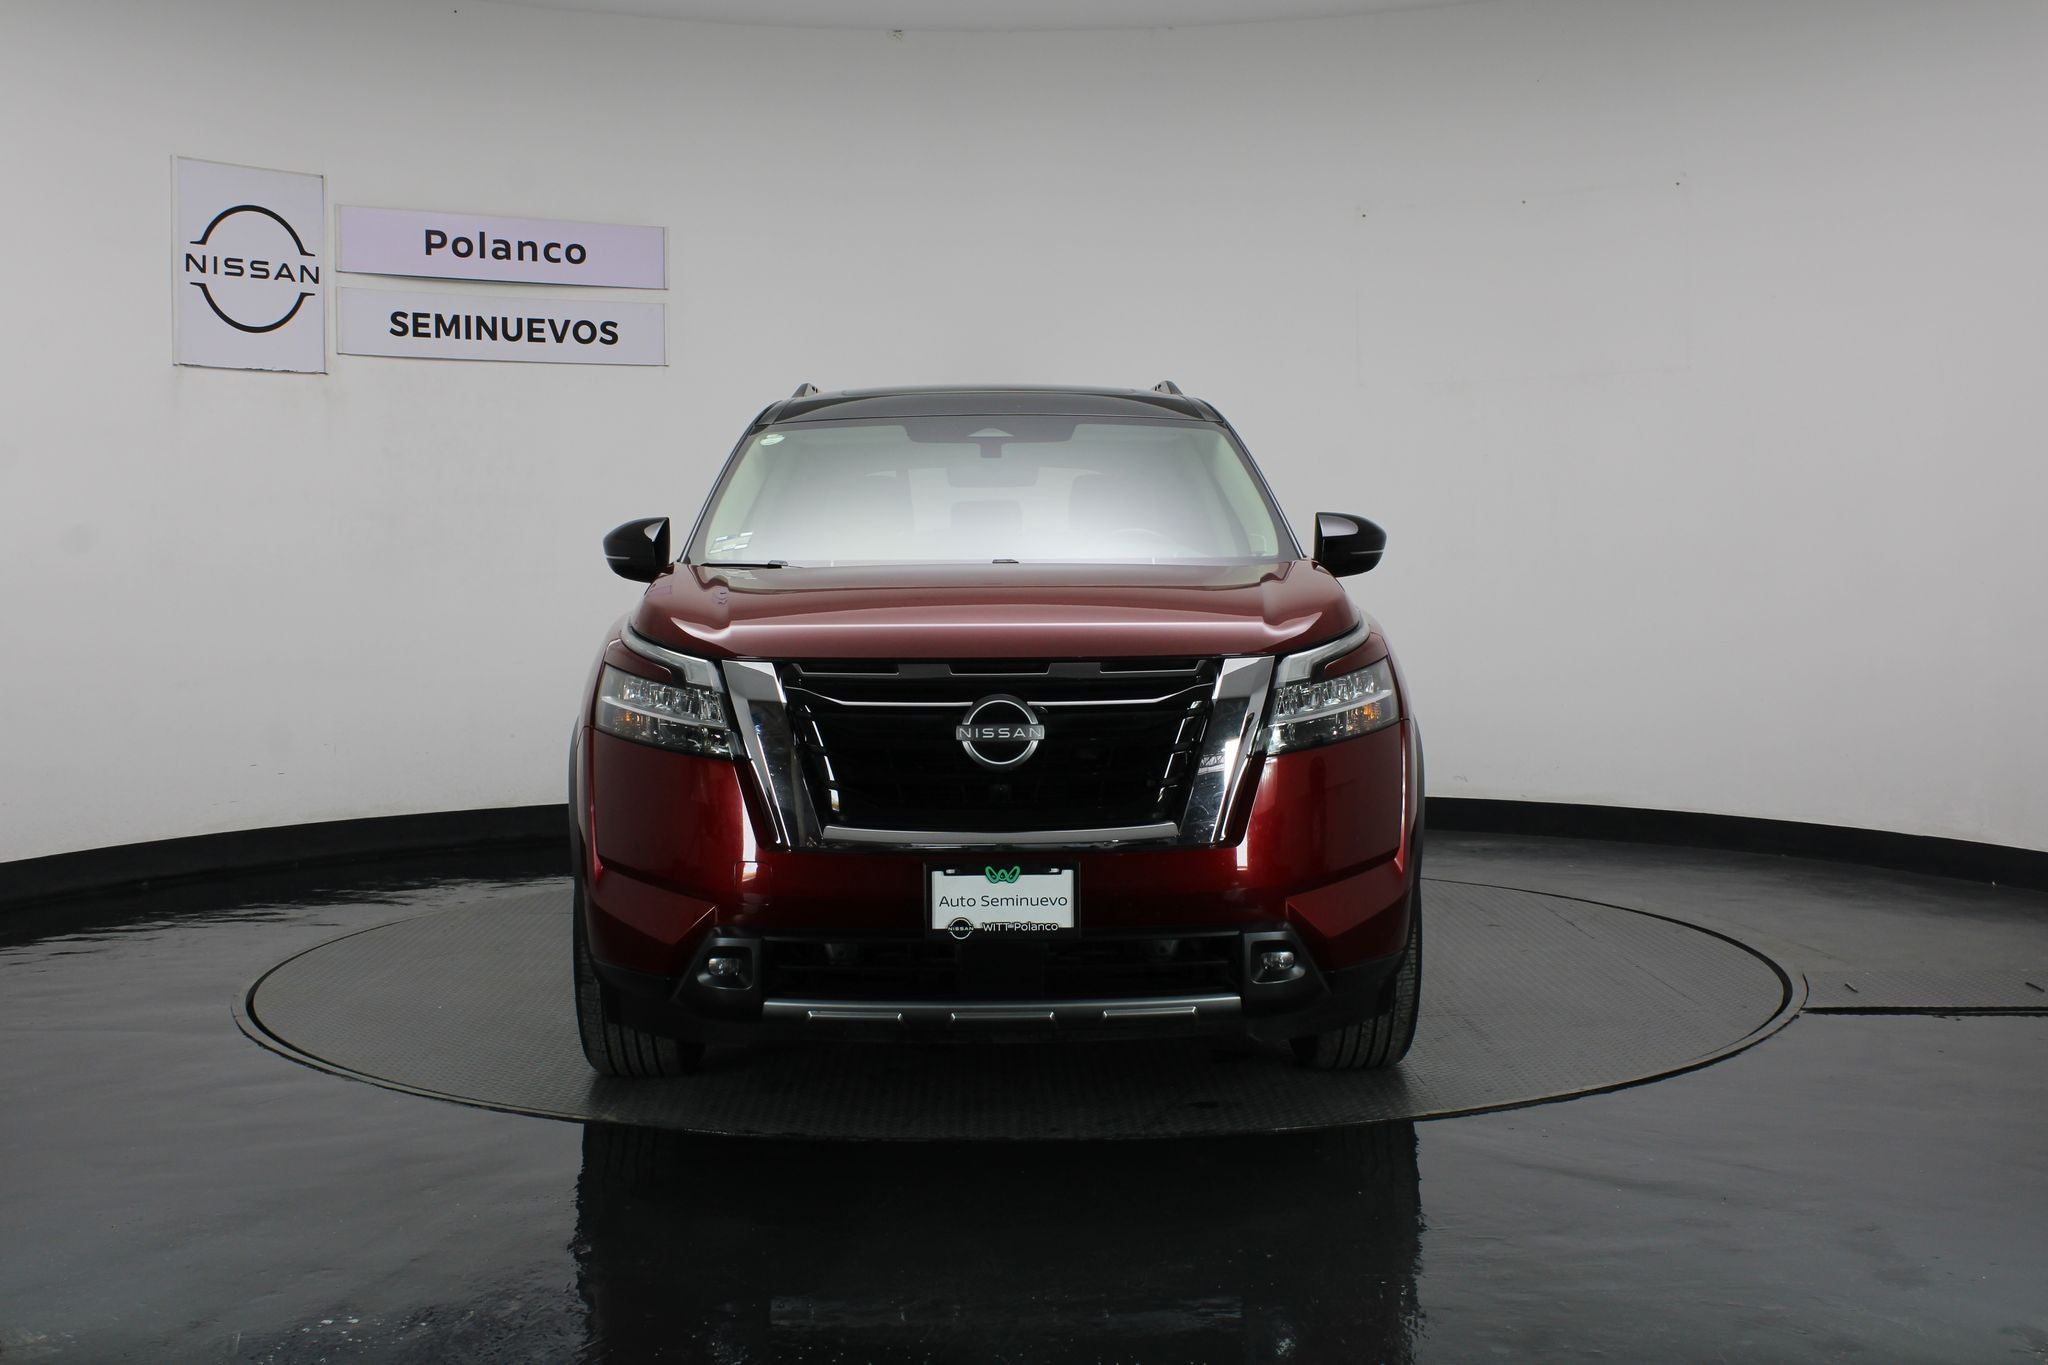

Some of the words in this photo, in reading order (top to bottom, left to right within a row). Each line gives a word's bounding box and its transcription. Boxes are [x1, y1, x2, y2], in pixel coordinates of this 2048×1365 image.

[424, 228, 588, 265] Polanco
[184, 252, 321, 285] NISSAN
[389, 311, 620, 346] SEMINUEVOS
[959, 727, 1041, 738] NISSAN
[938, 895, 977, 907] Auto
[980, 895, 1068, 907] Seminuevo
[982, 922, 1010, 932] WITT
[1013, 920, 1059, 932] Polanco
